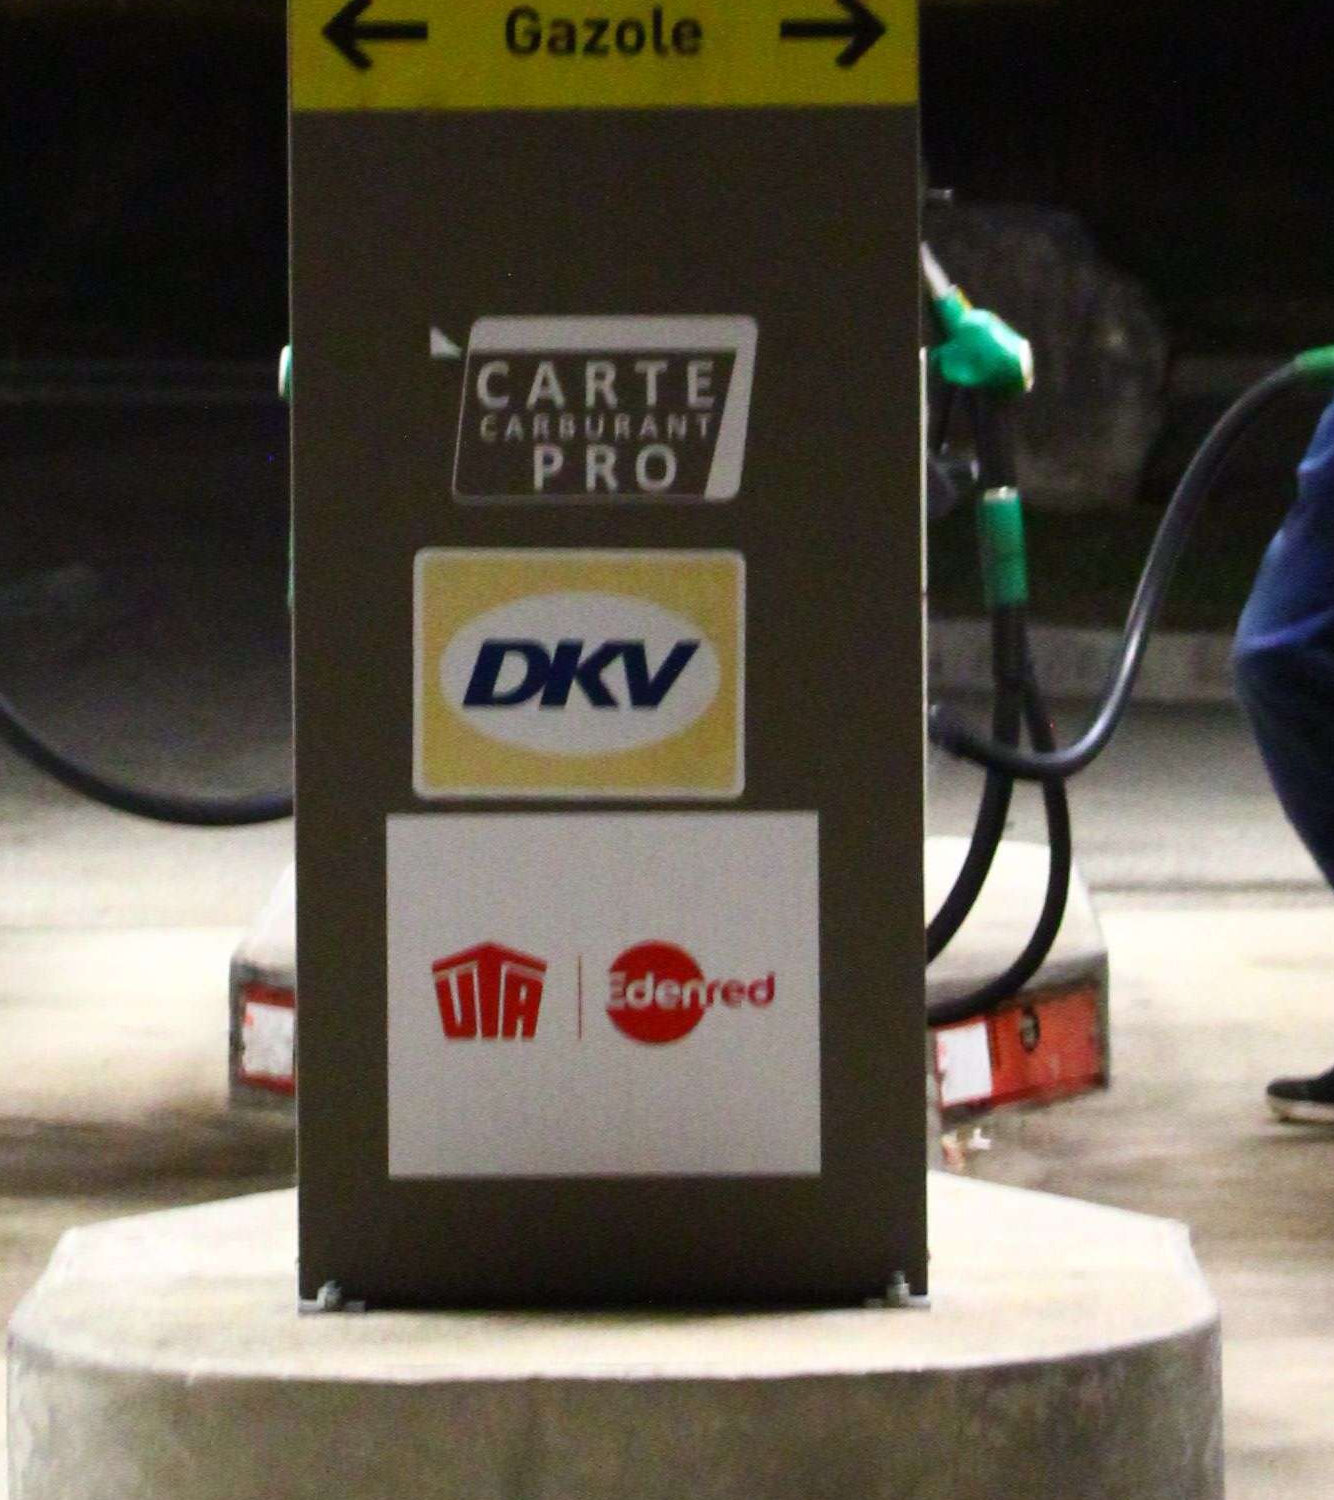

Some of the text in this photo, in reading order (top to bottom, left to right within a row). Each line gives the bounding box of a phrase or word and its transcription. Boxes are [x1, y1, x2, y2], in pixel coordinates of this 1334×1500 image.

[504, 5, 704, 58] Gazole
[476, 360, 715, 409] CARTE
[479, 413, 711, 441] CARBURANT
[533, 443, 677, 493] PRO
[462, 639, 700, 709] DKV
[431, 941, 547, 1041] UTA
[606, 970, 776, 1011] Edenred
